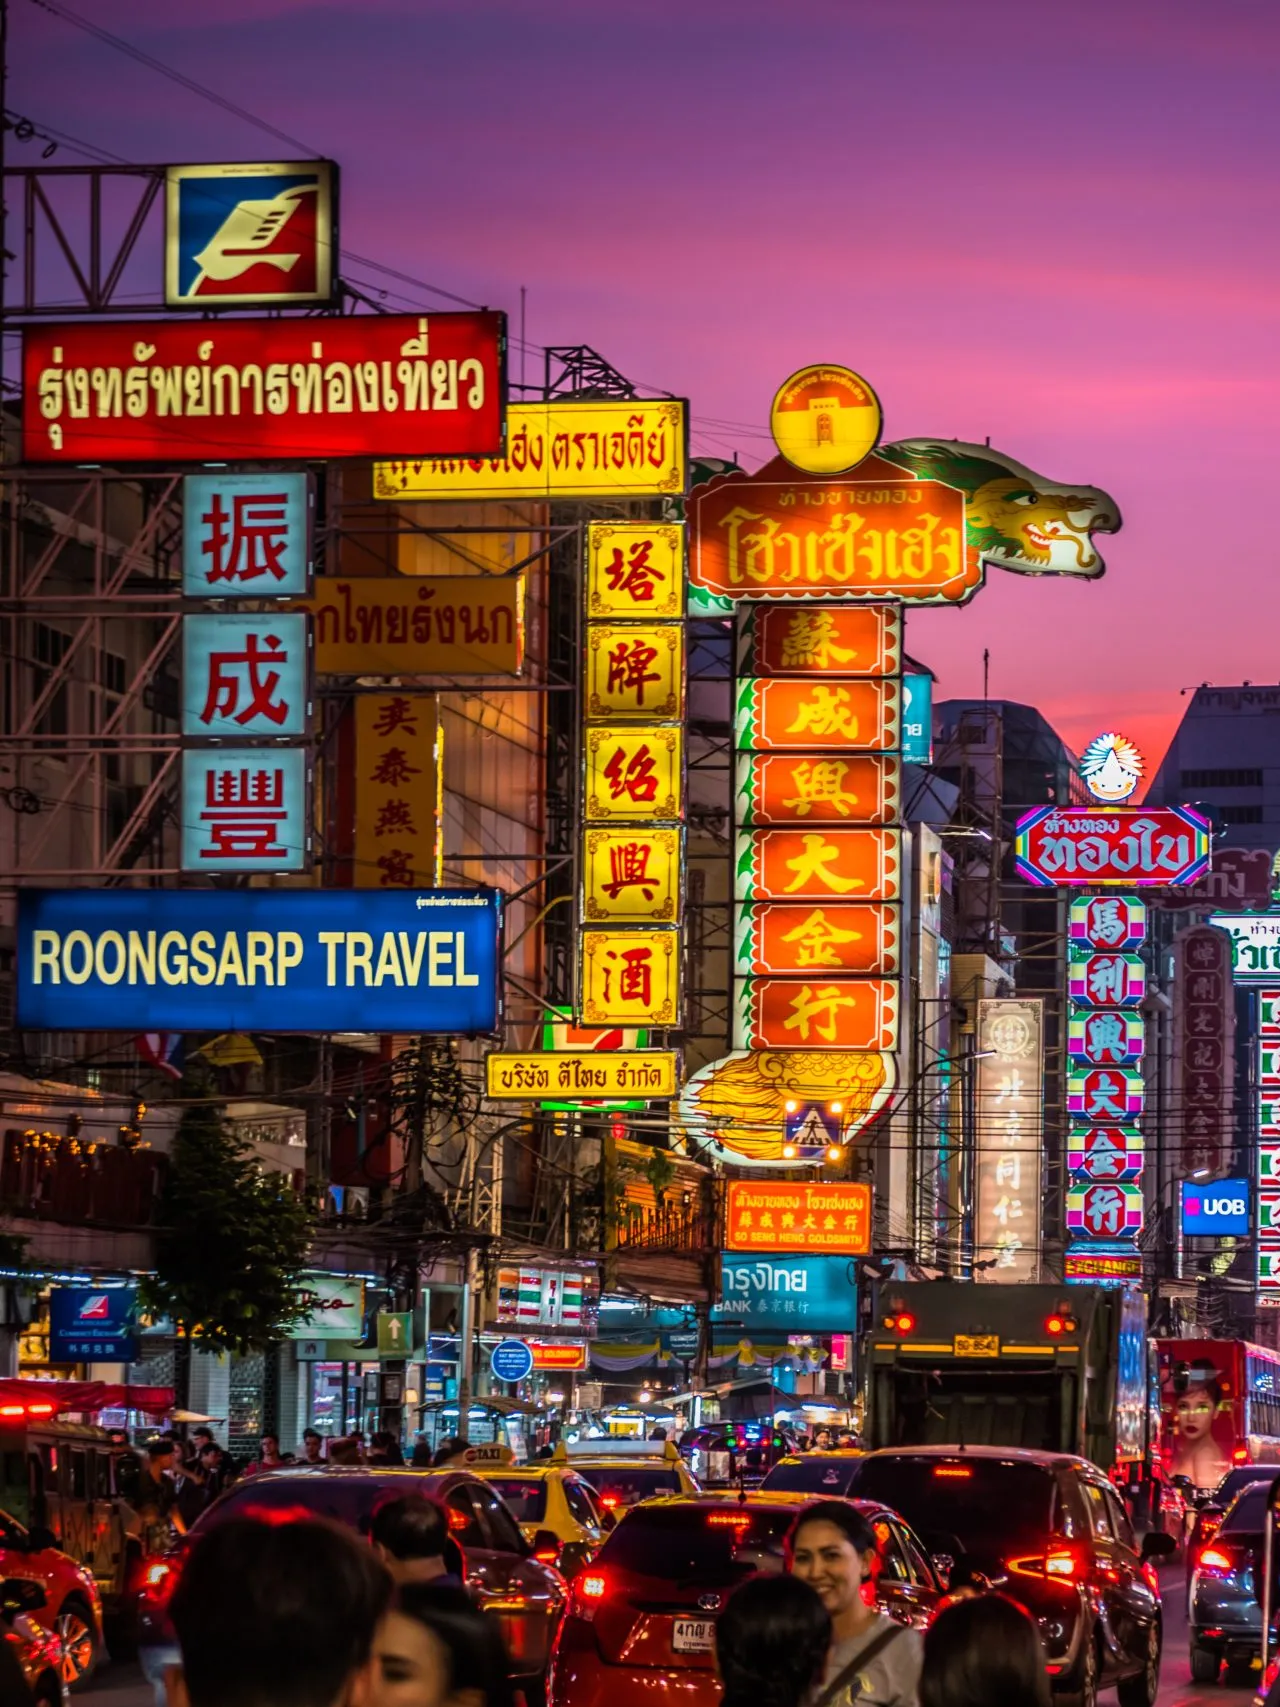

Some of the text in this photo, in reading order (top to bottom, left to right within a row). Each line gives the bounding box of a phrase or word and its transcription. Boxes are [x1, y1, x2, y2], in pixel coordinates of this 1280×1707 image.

[38, 318, 485, 451] รุ่งทรัพย์การท่องเที่ยว
[200, 492, 289, 859] 振成豐
[1044, 813, 1120, 833] ห้างทอง
[31, 929, 479, 987] ROONGSARP TRAVEL
[501, 1059, 662, 1089] บริษัท ดีไทย จำกัด
[1203, 1198, 1246, 1216] UOB
[734, 1232, 863, 1244] SO SENG HENG GOLDSMITH
[713, 1301, 752, 1313] BANK
[477, 1448, 500, 1460] TAXI
